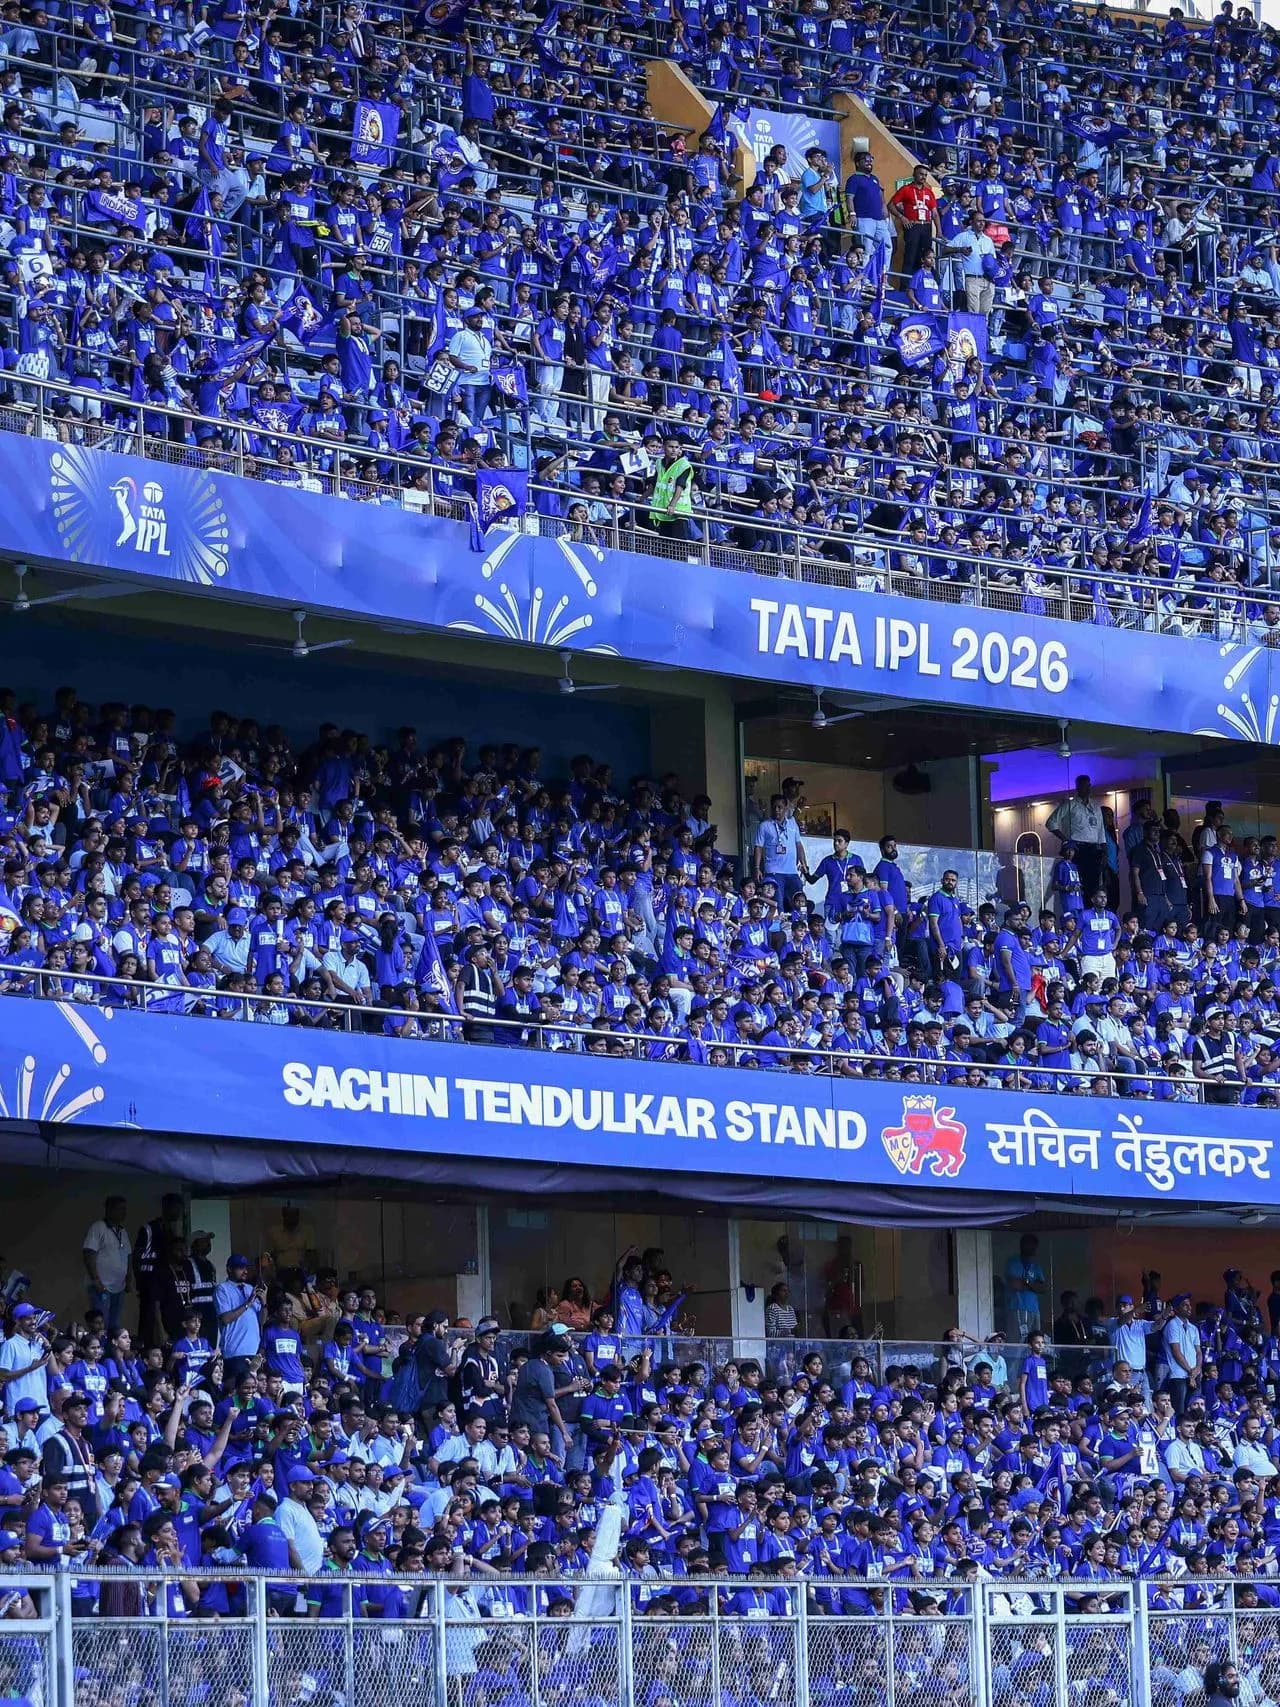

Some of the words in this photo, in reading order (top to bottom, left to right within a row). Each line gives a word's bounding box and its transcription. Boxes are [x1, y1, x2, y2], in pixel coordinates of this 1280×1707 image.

[357, 106, 370, 156] INDIAS
[754, 133, 775, 144] TATA
[753, 142, 776, 163] IP
[28, 257, 44, 274] 6
[426, 363, 450, 391] 283
[630, 452, 643, 467] 4
[140, 505, 166, 520] TATA
[135, 518, 171, 556] IPL
[750, 597, 862, 666] TATA
[874, 615, 942, 677] IPL
[951, 626, 1071, 694] 2026
[282, 1062, 449, 1118] SACHIN
[455, 1078, 718, 1140] TENDULKAR
[725, 1100, 867, 1150] STAND
[985, 1108, 1101, 1170] सचिन
[1111, 1113, 1274, 1191] तेंडुलकर
[1146, 1448, 1155, 1471] 4
